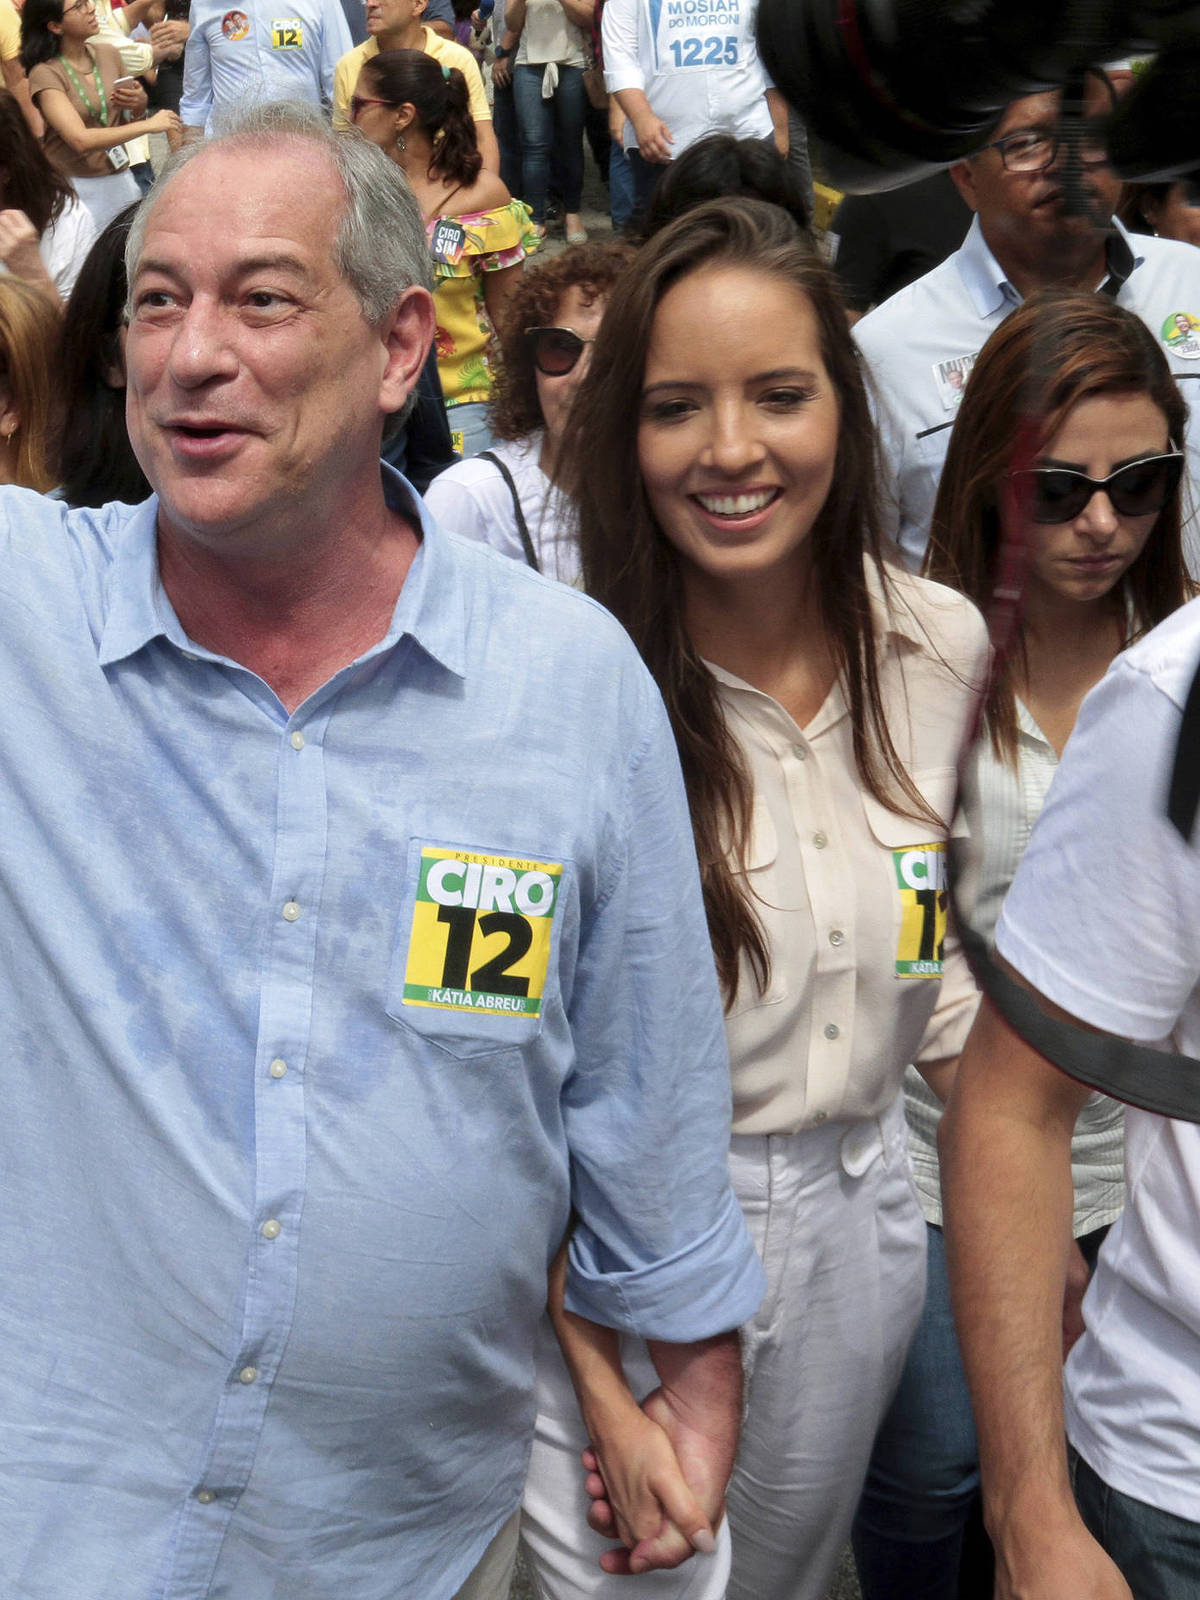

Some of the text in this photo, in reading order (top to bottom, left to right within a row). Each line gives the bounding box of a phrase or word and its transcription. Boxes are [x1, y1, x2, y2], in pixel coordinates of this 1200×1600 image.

[273, 20, 301, 30] CIRO
[669, 13, 739, 28] DO MORONI
[277, 29, 298, 46] 12
[669, 36, 738, 67] 1225
[439, 226, 460, 242] CIRO
[435, 238, 457, 257] SIM
[455, 852, 539, 871] PRESIDENTE
[426, 859, 555, 917] CIRO
[437, 904, 533, 998] 12
[432, 988, 473, 1006] KÁTIA
[475, 994, 521, 1012] ABREU
